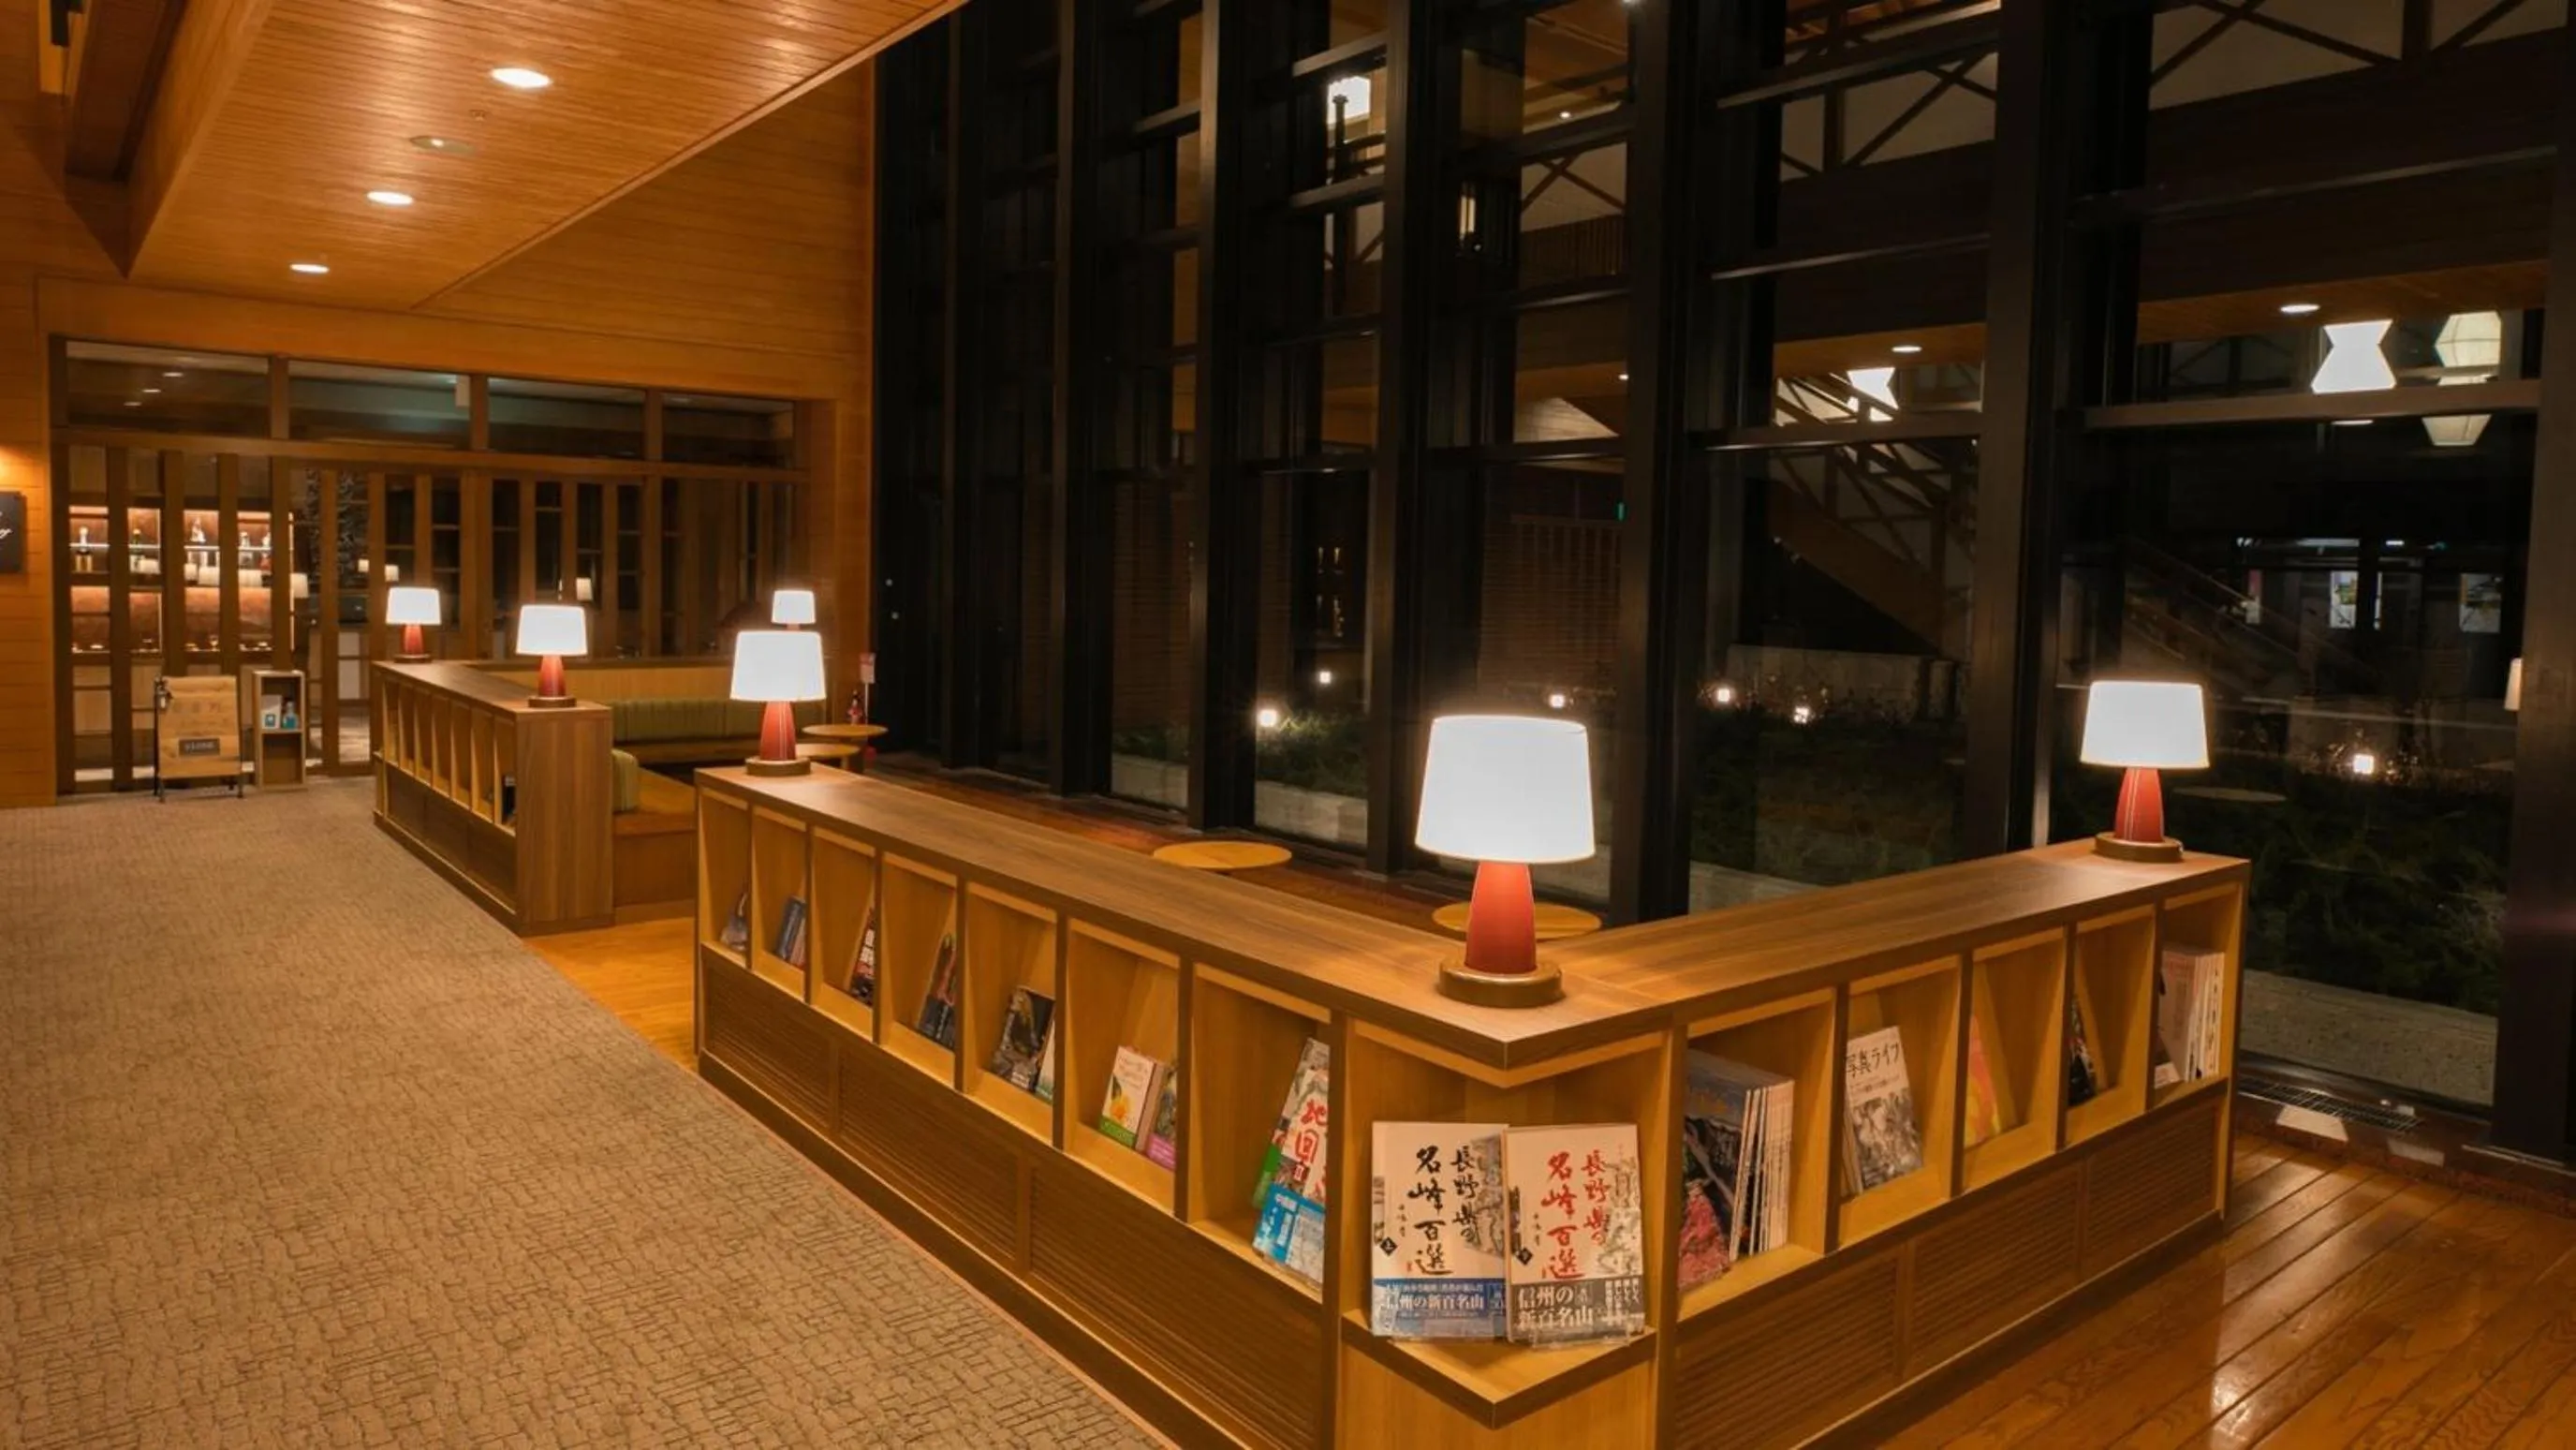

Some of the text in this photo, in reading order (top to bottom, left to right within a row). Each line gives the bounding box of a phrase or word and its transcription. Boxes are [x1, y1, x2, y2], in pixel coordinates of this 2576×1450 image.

[1407, 1145, 1454, 1275] 名峰百選
[1540, 1151, 1584, 1280] 名峰百選
[1386, 1293, 1484, 1310] 信州の新百名山
[1518, 1285, 1574, 1309] 信州の
[1516, 1305, 1594, 1330] 新百名山
